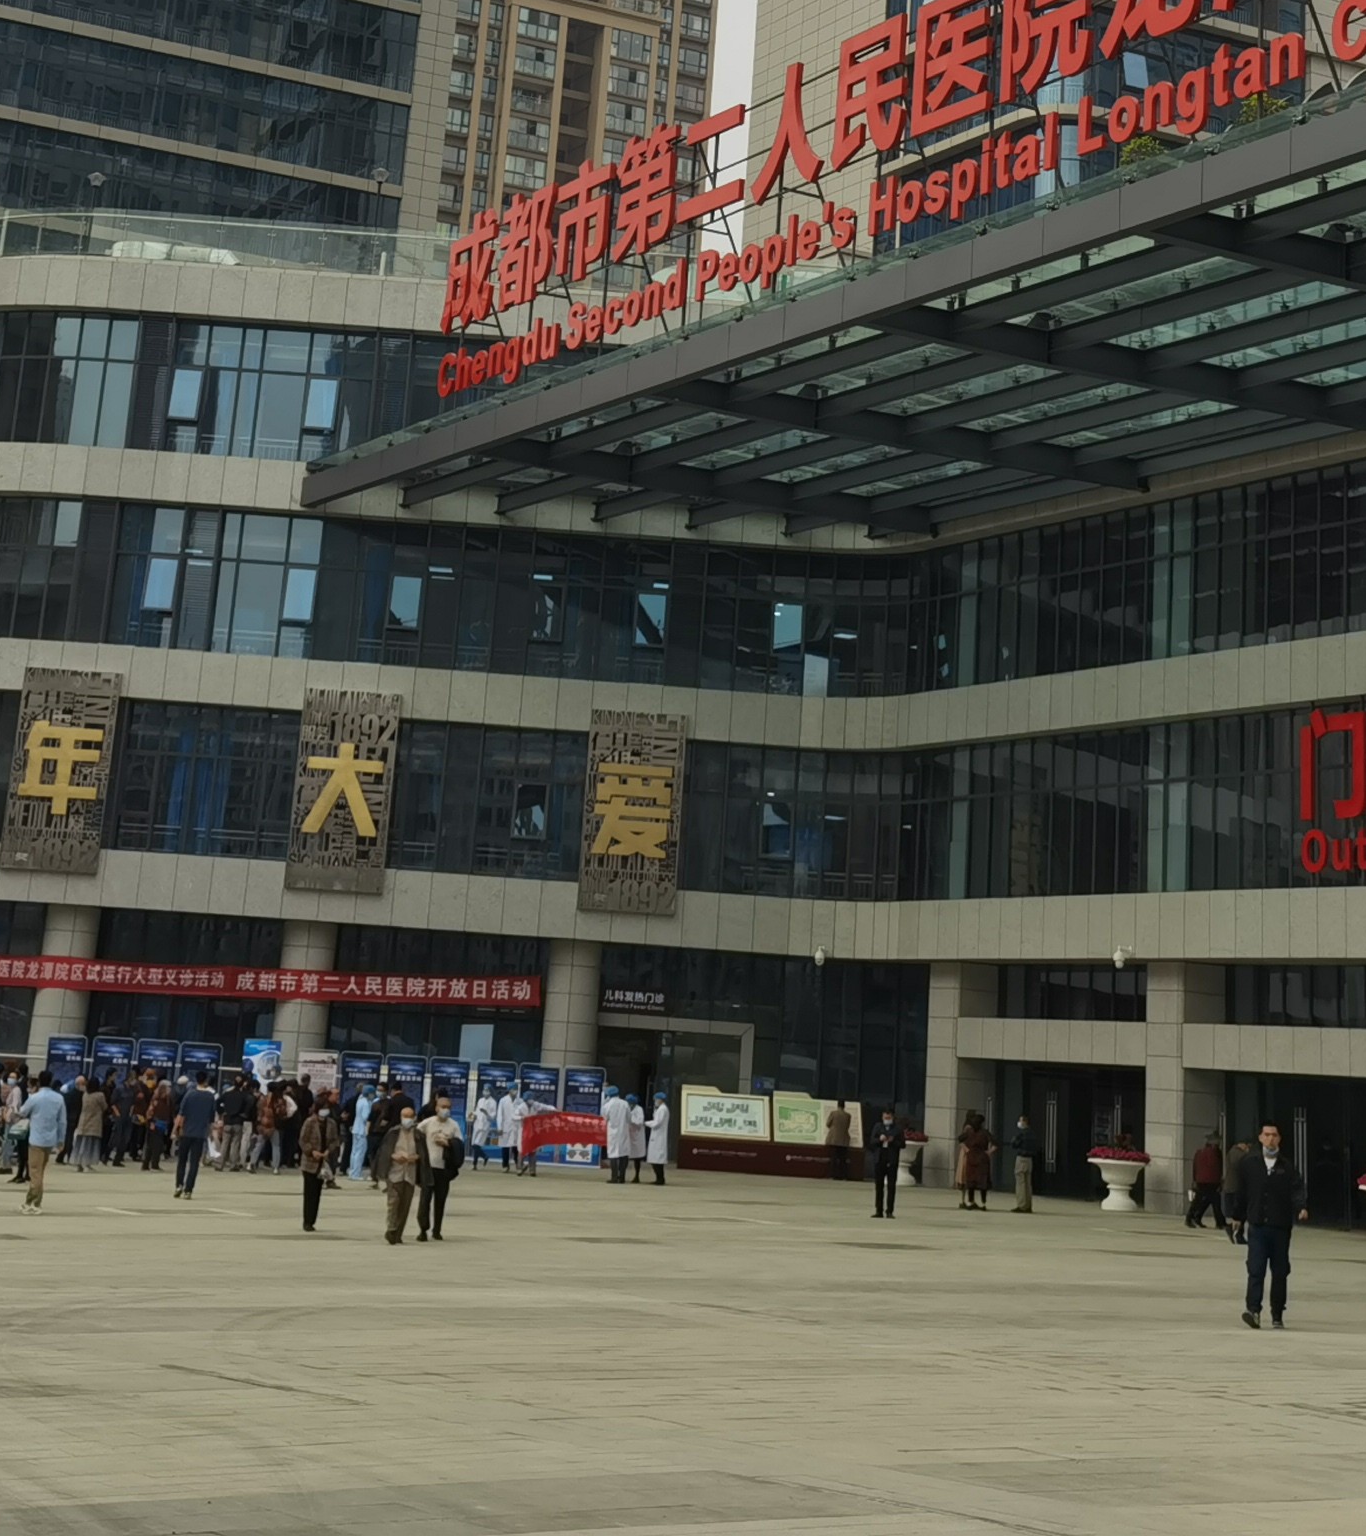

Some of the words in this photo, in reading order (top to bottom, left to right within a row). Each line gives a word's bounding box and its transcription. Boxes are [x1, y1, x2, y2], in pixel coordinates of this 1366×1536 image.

[438, 318, 561, 397] Chengdu
[565, 258, 685, 349] Second
[695, 201, 857, 302] People's
[868, 111, 1059, 236] Hospital
[1077, 30, 1306, 156] Longtan
[17, 720, 104, 815] 年
[330, 710, 398, 745] 1892
[301, 742, 385, 837] 大
[590, 762, 675, 859] 爱
[607, 880, 676, 914] 1892
[235, 970, 532, 1001] 成都市第二人民医院开放日活动
